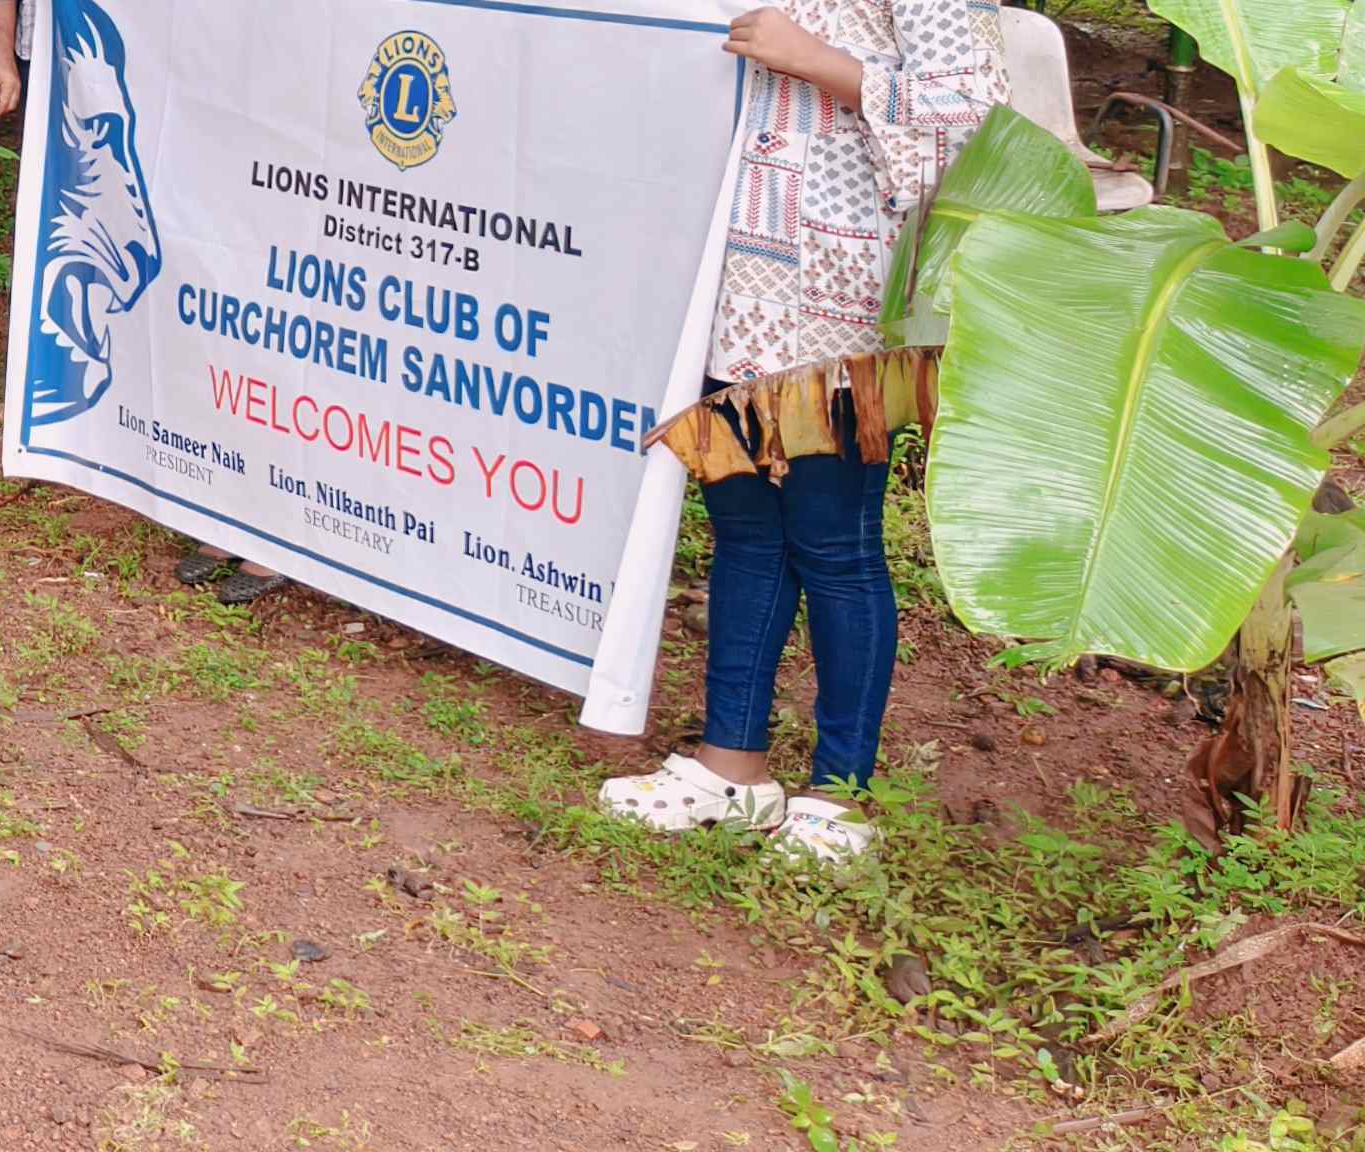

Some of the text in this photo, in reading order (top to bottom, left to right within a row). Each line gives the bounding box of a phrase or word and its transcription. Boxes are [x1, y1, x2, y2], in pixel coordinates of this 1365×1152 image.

[384, 36, 440, 68] LIONS
[394, 74, 420, 123] L
[251, 161, 582, 257] LIONS INTERNATIONAL
[324, 215, 480, 272] District 317-B
[178, 284, 388, 383] CURCHOREM
[266, 245, 550, 358] LIONS CLUB OF
[119, 405, 245, 475] Lion. Sameer Naik
[146, 445, 213, 486] PRESIDENT
[210, 364, 583, 524] WELCOMES YOU
[269, 464, 435, 543] Lion. Nilkanth Pai
[304, 508, 394, 555] SECRETARY
[463, 531, 602, 602] Lion. Ashwin
[517, 584, 604, 632] TREASUR
